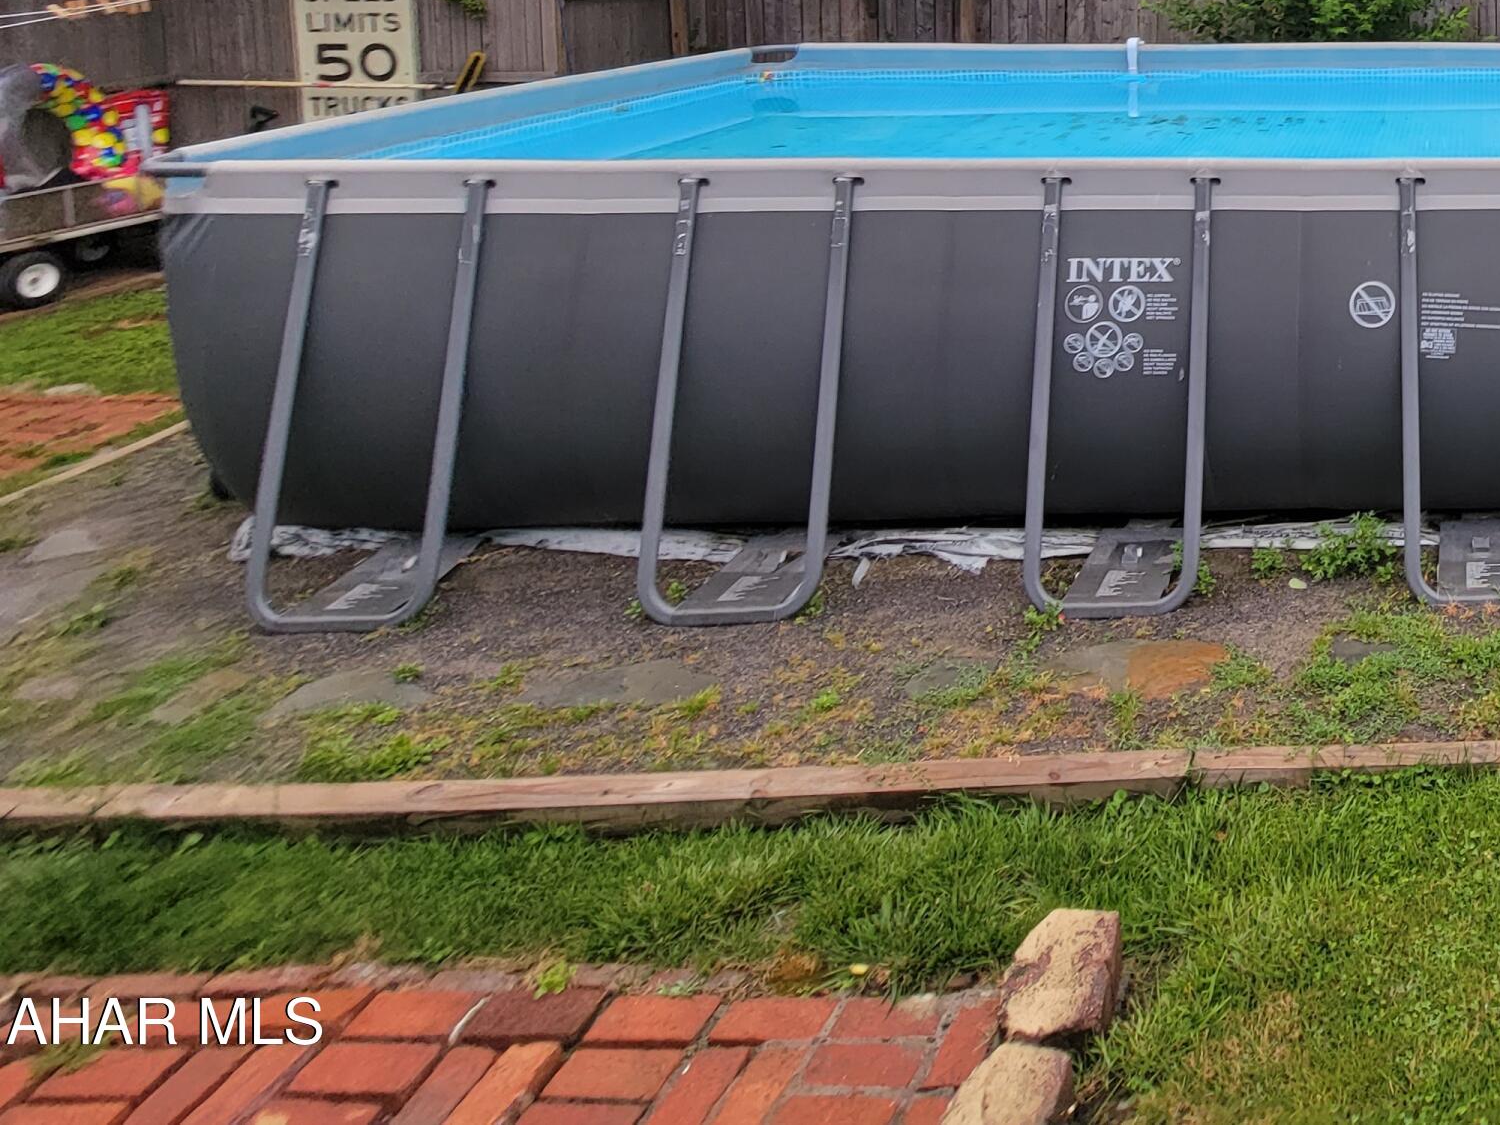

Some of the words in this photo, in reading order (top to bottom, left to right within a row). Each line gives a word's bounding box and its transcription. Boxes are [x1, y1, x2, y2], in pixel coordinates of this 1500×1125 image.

[305, 12, 401, 33] LIMITS
[316, 42, 397, 82] 50
[308, 95, 409, 117] TRUCK
